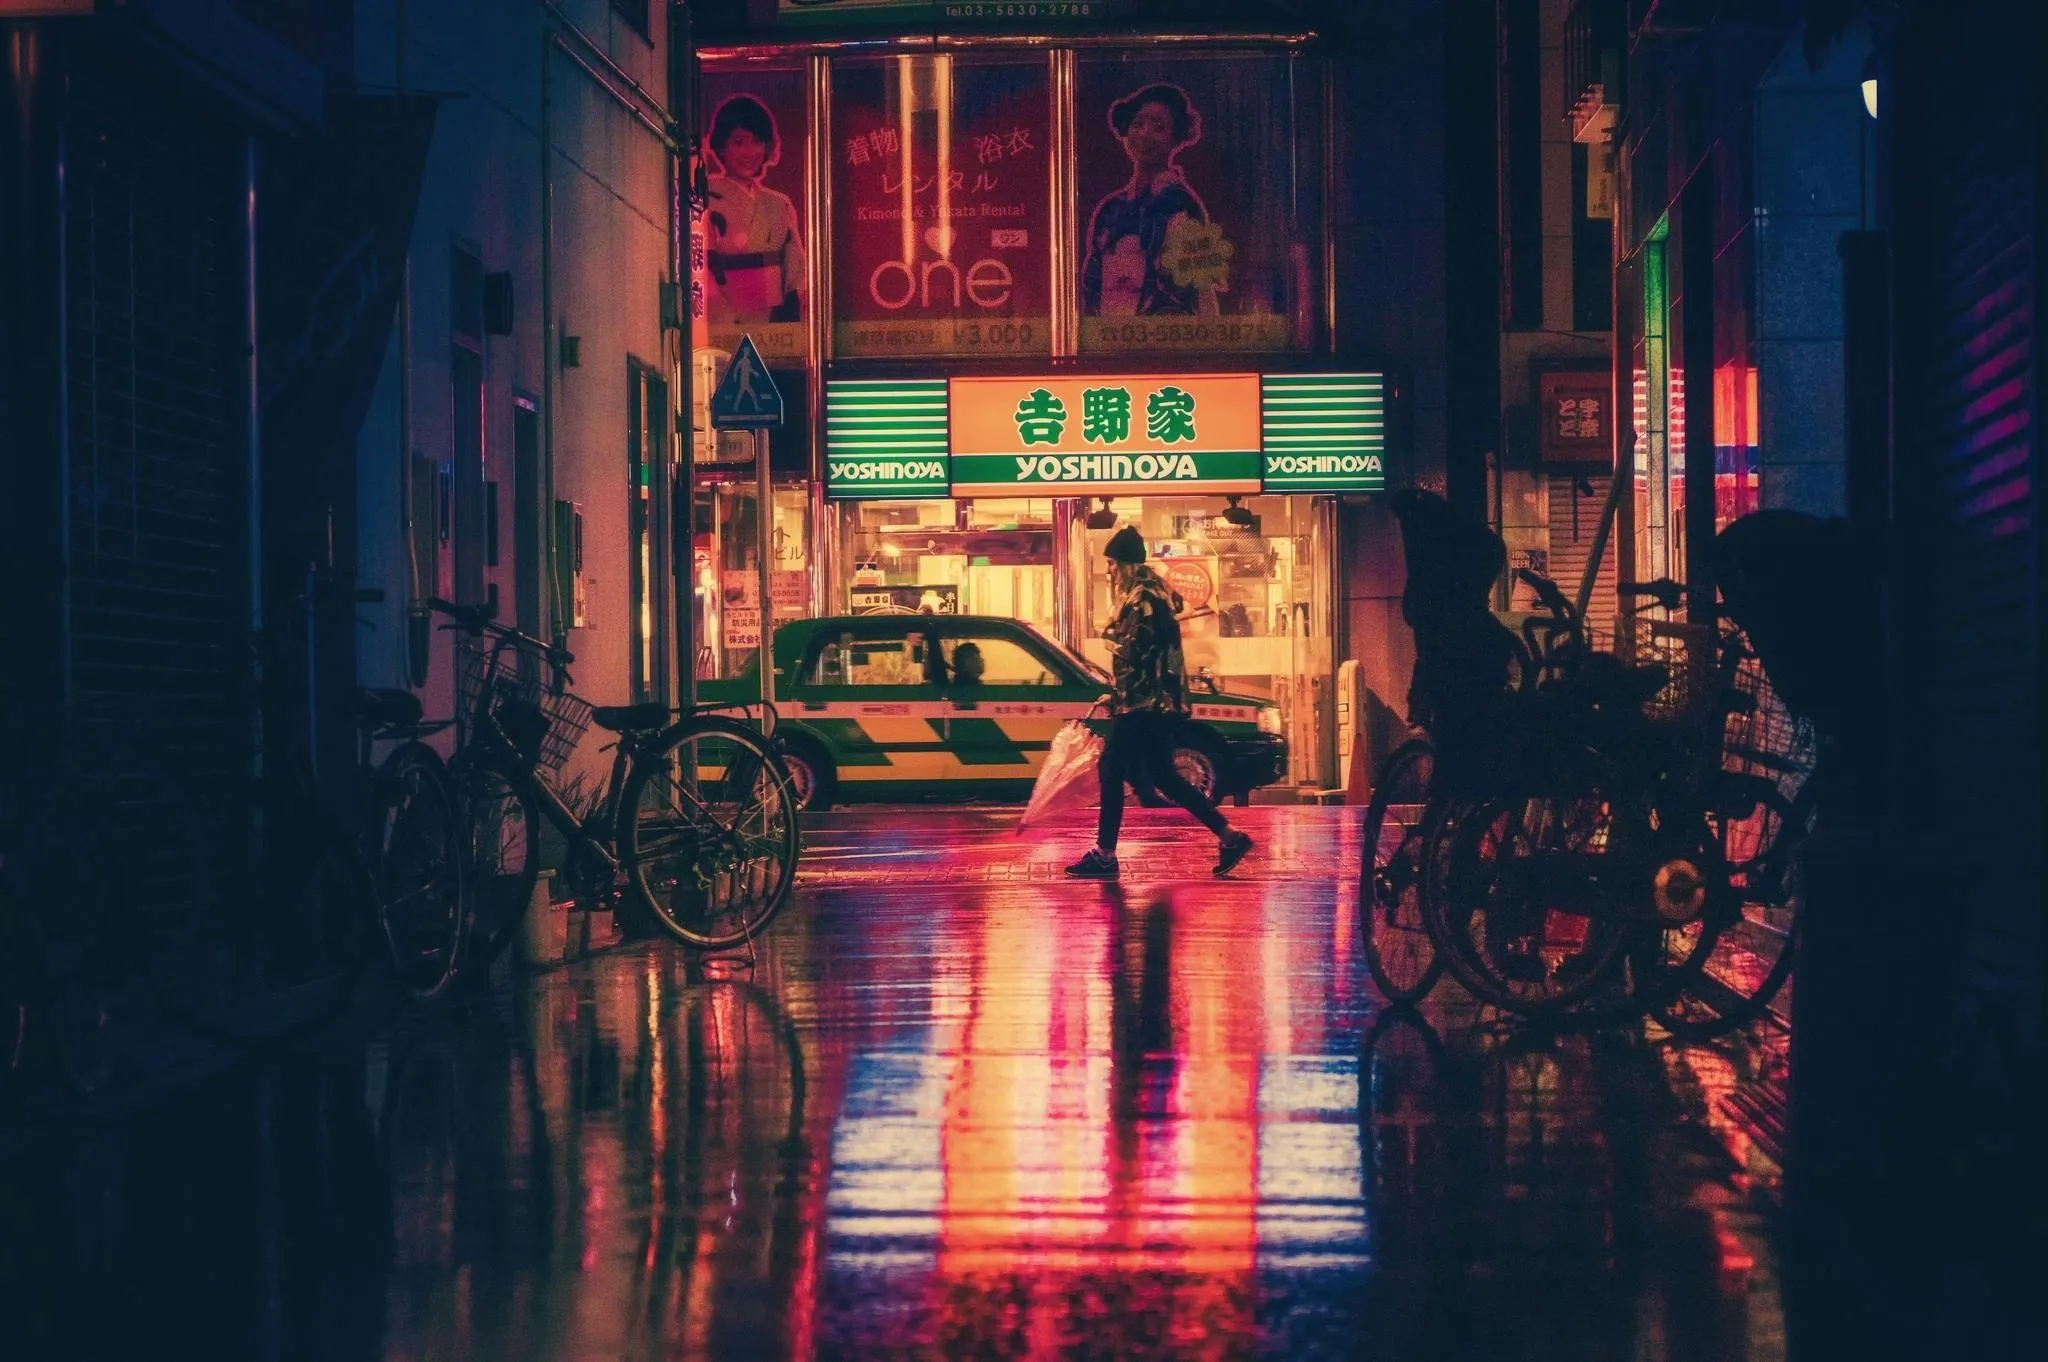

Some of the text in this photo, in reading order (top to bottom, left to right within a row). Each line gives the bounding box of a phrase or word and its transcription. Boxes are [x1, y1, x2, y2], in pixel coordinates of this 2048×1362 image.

[843, 127, 1035, 166] 着物 浴衣
[869, 258, 1013, 310] one
[830, 461, 945, 480] YOSHINOYA
[1016, 454, 1198, 481] YOSHINOYA
[1267, 454, 1382, 474] YOSHINOYA
